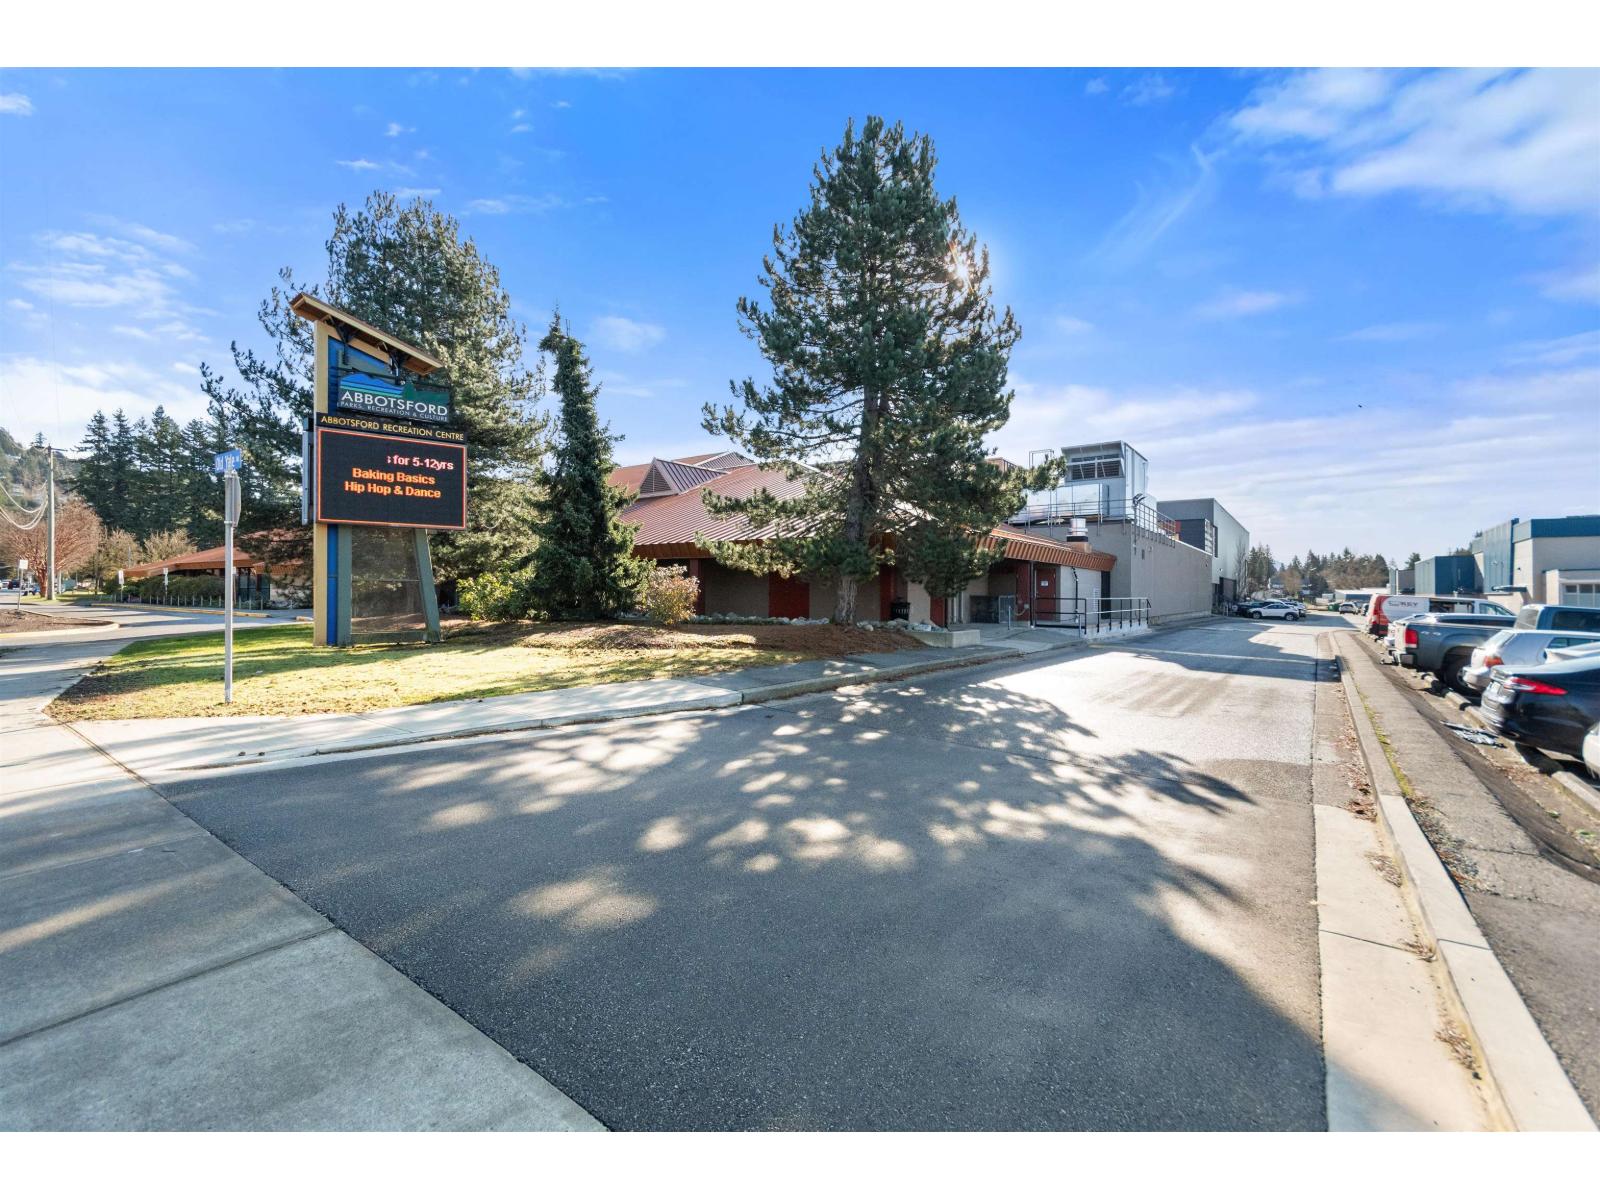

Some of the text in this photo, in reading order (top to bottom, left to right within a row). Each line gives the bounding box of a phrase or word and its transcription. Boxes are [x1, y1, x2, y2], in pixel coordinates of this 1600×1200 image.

[341, 390, 448, 416] ABBOTSFORD
[367, 405, 410, 416] RECREATION
[419, 413, 448, 422] CULTURE
[320, 415, 464, 441] ABBOTSFORD RECREATION CENTRE
[393, 455, 410, 465] for
[412, 457, 454, 470] 5-12yrs
[352, 467, 436, 485] Baking Basics
[344, 481, 442, 499] Hip Hop & Dance
